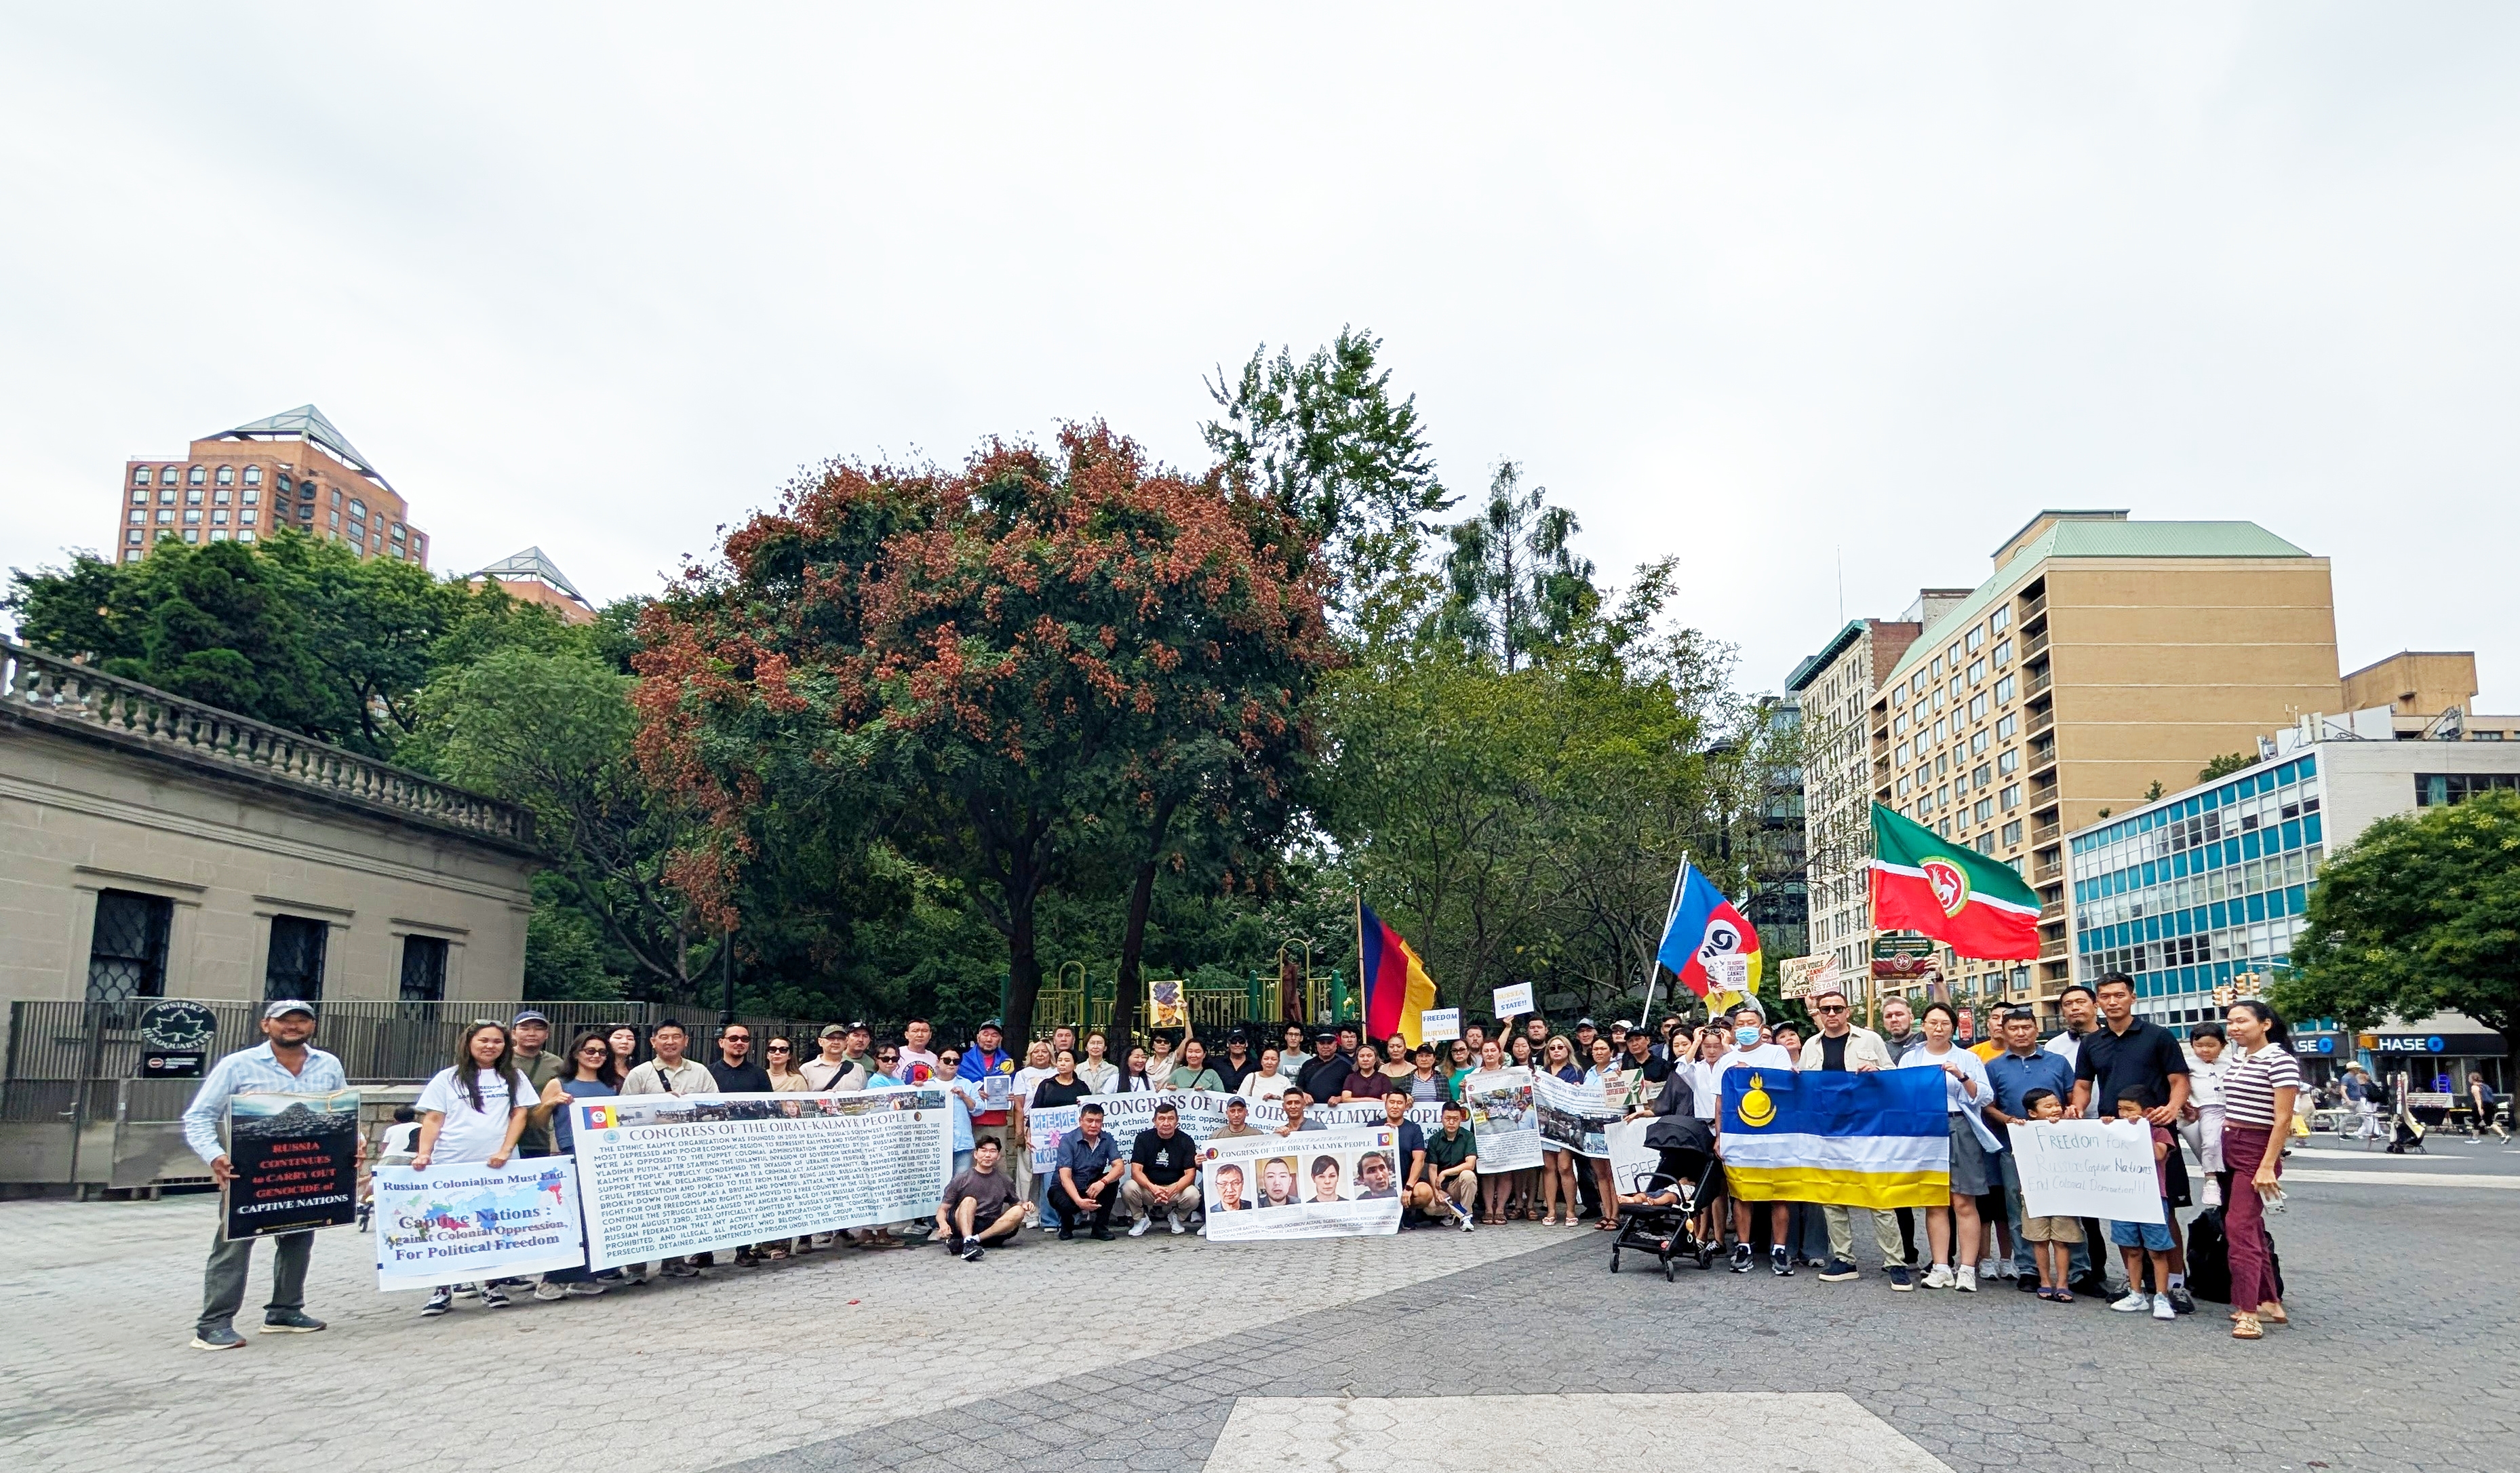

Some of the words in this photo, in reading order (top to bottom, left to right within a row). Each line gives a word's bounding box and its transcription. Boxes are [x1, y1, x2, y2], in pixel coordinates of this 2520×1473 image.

[1806, 967, 1826, 976] CANNOT
[1807, 960, 1824, 970] VOICE
[1816, 970, 1838, 981] SILENCED
[1789, 981, 1838, 996] TATARSTAN
[157, 1002, 206, 1013] DISTRICT
[1423, 1013, 1457, 1021] FREEDOM
[142, 1028, 214, 1049] HEADQUARTERS
[2371, 1038, 2426, 1050] HASE
[1099, 1095, 1186, 1116] CONGRESS
[1191, 1095, 1212, 1109] OF
[1217, 1099, 1250, 1117] TE
[1255, 1105, 1383, 1124] OIR-KALMYK
[629, 1124, 715, 1141] CONGRESS
[719, 1124, 737, 1135] OF
[740, 1122, 767, 1134] THE
[770, 1118, 859, 1133] OIRAT-KALMYK
[863, 1113, 906, 1127] PEOPLE
[1118, 1127, 1149, 1137] August
[1177, 1124, 1198, 1132] 2023,
[1122, 1118, 1151, 1126] ethnic
[273, 1142, 320, 1153] RUSSIA
[678, 1138, 730, 1147] ORGANIZATION
[1288, 1142, 1343, 1152] OIRAT-KALMYK
[259, 1156, 331, 1168] CONTINUES
[620, 1151, 660, 1159] DEPRESSED
[637, 1157, 672, 1165] OPPOSED
[266, 1171, 307, 1182] CARRY
[311, 1168, 336, 1178] OUT
[595, 1168, 634, 1177] VLADIMIR
[687, 1160, 719, 1168] STARTING
[597, 1176, 629, 1185] KALMYK
[669, 1169, 701, 1177] PUBLICLY
[705, 1165, 746, 1173] CONDEMNED
[1617, 1160, 1657, 1188] FREE
[2115, 1158, 2152, 1175] Nations
[383, 1182, 429, 1190] Russian
[433, 1178, 503, 1190] Colonialism
[508, 1174, 536, 1184] Must
[539, 1171, 567, 1181] End.
[598, 1183, 635, 1193] SUPPORT
[675, 1175, 713, 1185] DECLARING
[2028, 1177, 2048, 1192] End
[2053, 1175, 2085, 1191] Colonial
[256, 1184, 320, 1198] GENOCIDE
[627, 1187, 677, 1198] PERSECUTION
[698, 1181, 726, 1190] FORCED
[238, 1200, 294, 1214] CAPTIVE
[297, 1194, 349, 1206] NATIONS
[600, 1200, 633, 1209] BROKEN
[602, 1209, 624, 1217] FIGHT
[664, 1200, 701, 1209] FREEDOMS
[476, 1208, 540, 1222] Nations
[602, 1215, 644, 1225] CONTINUE
[663, 1208, 698, 1217] STRUGGLE
[642, 1219, 670, 1228] AUGUST
[715, 1208, 751, 1218] OFFICIALLY
[385, 1234, 433, 1249] Against
[437, 1228, 492, 1241] Colonial
[495, 1220, 568, 1236] Oppression,
[604, 1231, 639, 1242] RUSSIAN
[643, 1225, 687, 1236] FEDERATION
[606, 1238, 655, 1250] PROHIBITED,
[730, 1223, 755, 1231] PEOPLE
[395, 1249, 423, 1261] For
[429, 1240, 491, 1259] Political
[495, 1235, 559, 1250] Freedom
[606, 1246, 656, 1258] PERSECUTED,
[658, 1240, 696, 1249] DETAINED,
[715, 1230, 751, 1241] SENTENCED
